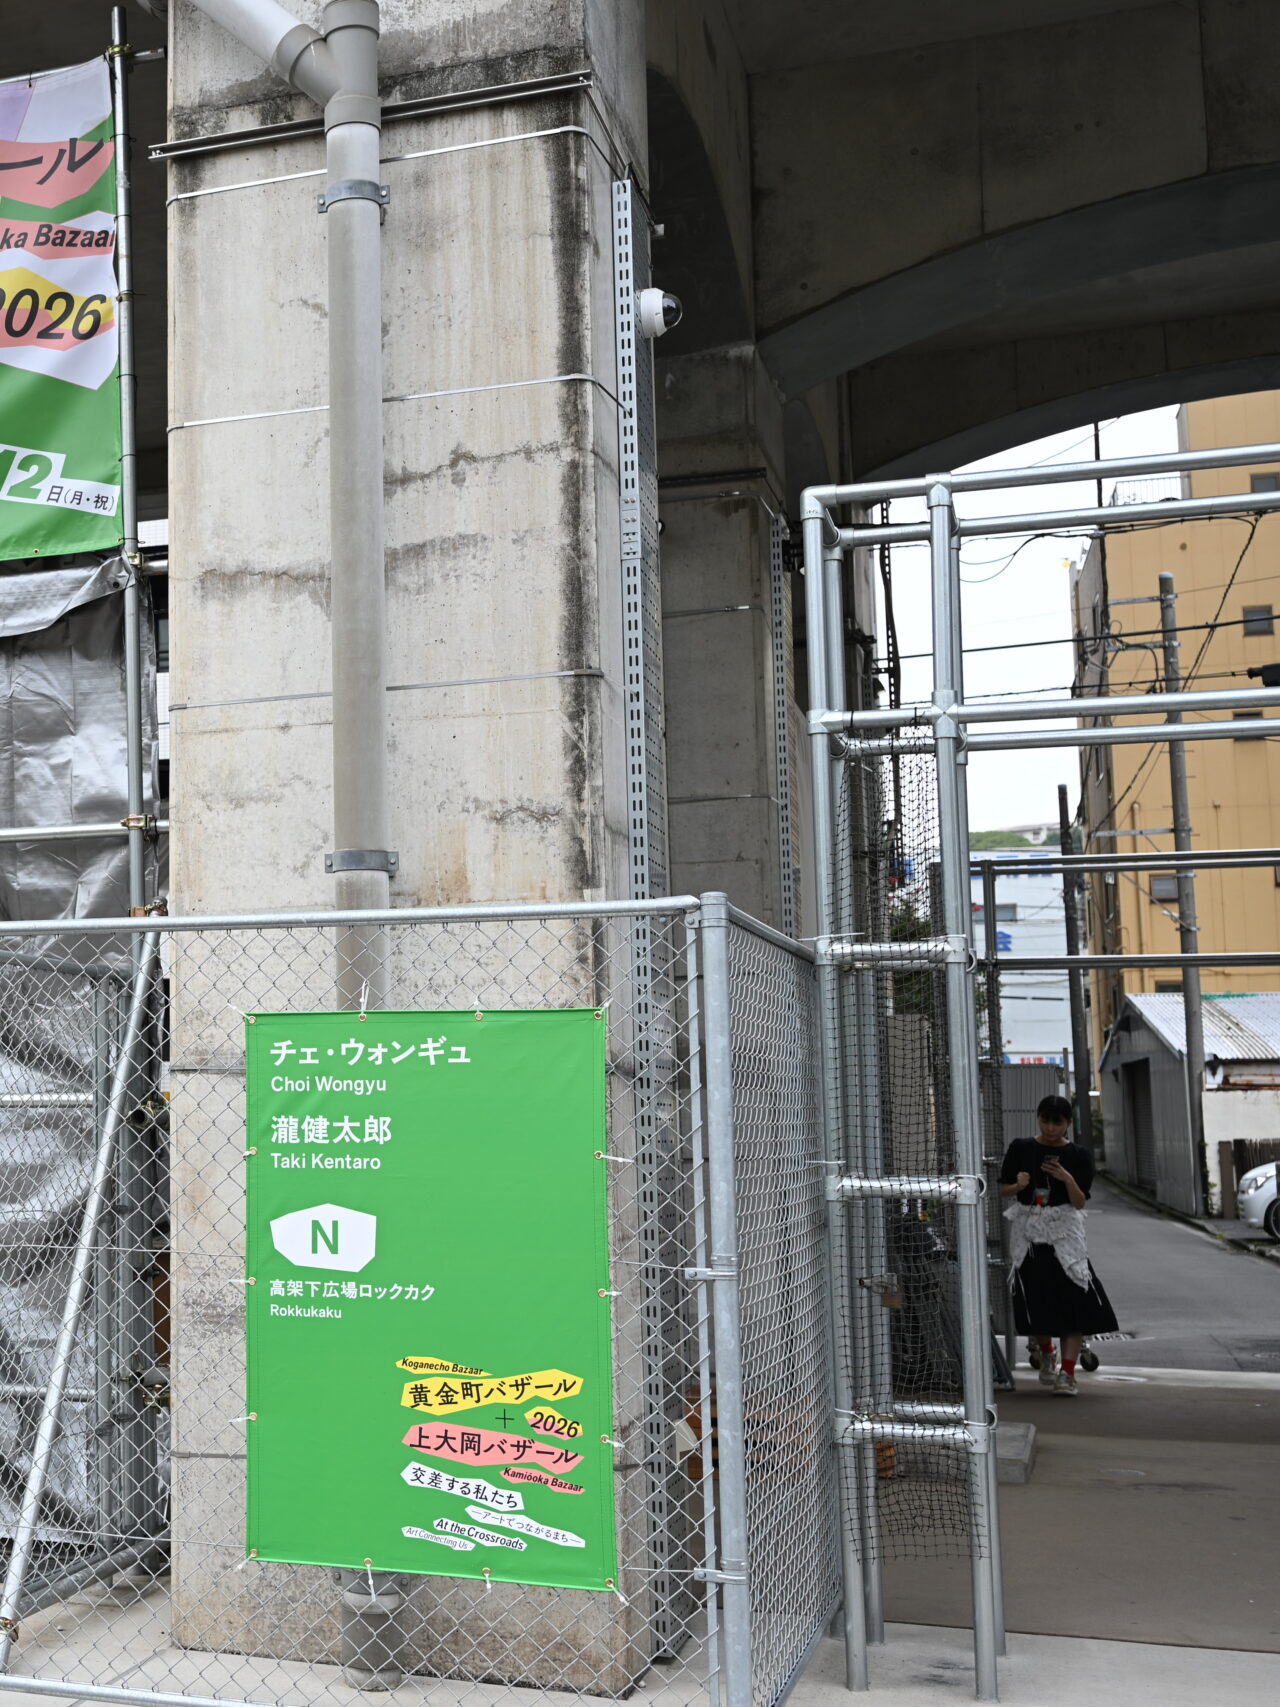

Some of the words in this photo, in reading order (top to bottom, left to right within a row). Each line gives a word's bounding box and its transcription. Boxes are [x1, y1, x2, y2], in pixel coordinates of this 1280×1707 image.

[270, 1036, 471, 1066] チェ・ウォンギュ
[270, 1076, 311, 1092] Choi
[315, 1076, 387, 1096] Wongyu
[271, 1115, 392, 1144] 瀧健太郎
[270, 1153, 306, 1168] Taki
[311, 1153, 381, 1169] Kentaro
[311, 1220, 339, 1254] N
[269, 1279, 435, 1301] 高架下広場ロックカク
[270, 1304, 342, 1319] Rokkukaku
[401, 1358, 450, 1372] Koganecho
[452, 1363, 483, 1376] Bazaar
[409, 1375, 577, 1409] 黄金町バザール
[530, 1411, 580, 1439] 2026
[409, 1426, 578, 1465] 上大岡バザール
[410, 1466, 518, 1509] 交差する私たち
[551, 1477, 583, 1492] Bazaar
[406, 1527, 419, 1537] Art
[419, 1529, 458, 1549] Connecting
[458, 1540, 468, 1549] Us
[435, 1519, 449, 1531] At
[450, 1522, 466, 1535] the
[467, 1526, 524, 1550] Crossroads
